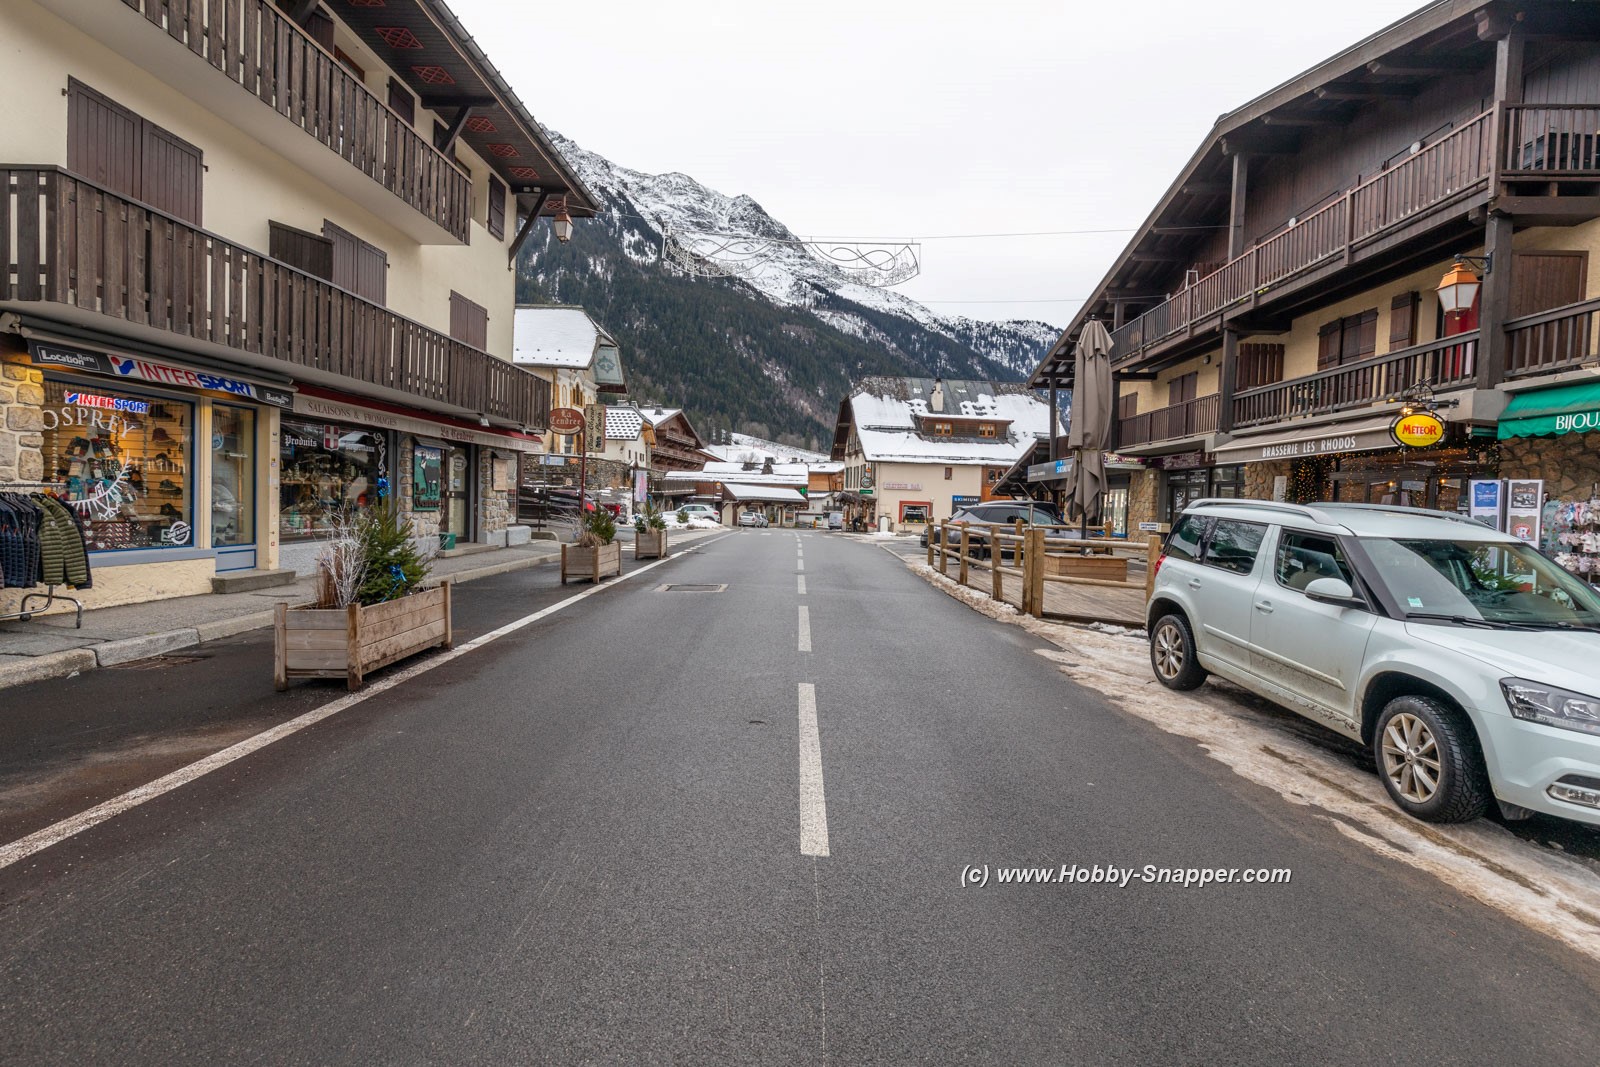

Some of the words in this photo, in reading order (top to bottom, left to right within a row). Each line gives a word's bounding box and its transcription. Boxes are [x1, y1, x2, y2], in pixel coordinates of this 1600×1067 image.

[137, 361, 252, 396] INTERSPORT
[78, 393, 149, 413] INTERSPORT
[308, 402, 351, 417] SALAISONS
[354, 411, 360, 419] &
[43, 406, 136, 438] OSPREY
[562, 410, 571, 418] La
[1556, 412, 1600, 431] BIJOU
[285, 434, 318, 447] Produits
[1262, 443, 1298, 458] BRASSERIE
[1303, 441, 1316, 453] LES
[1320, 436, 1356, 451] RHODOS
